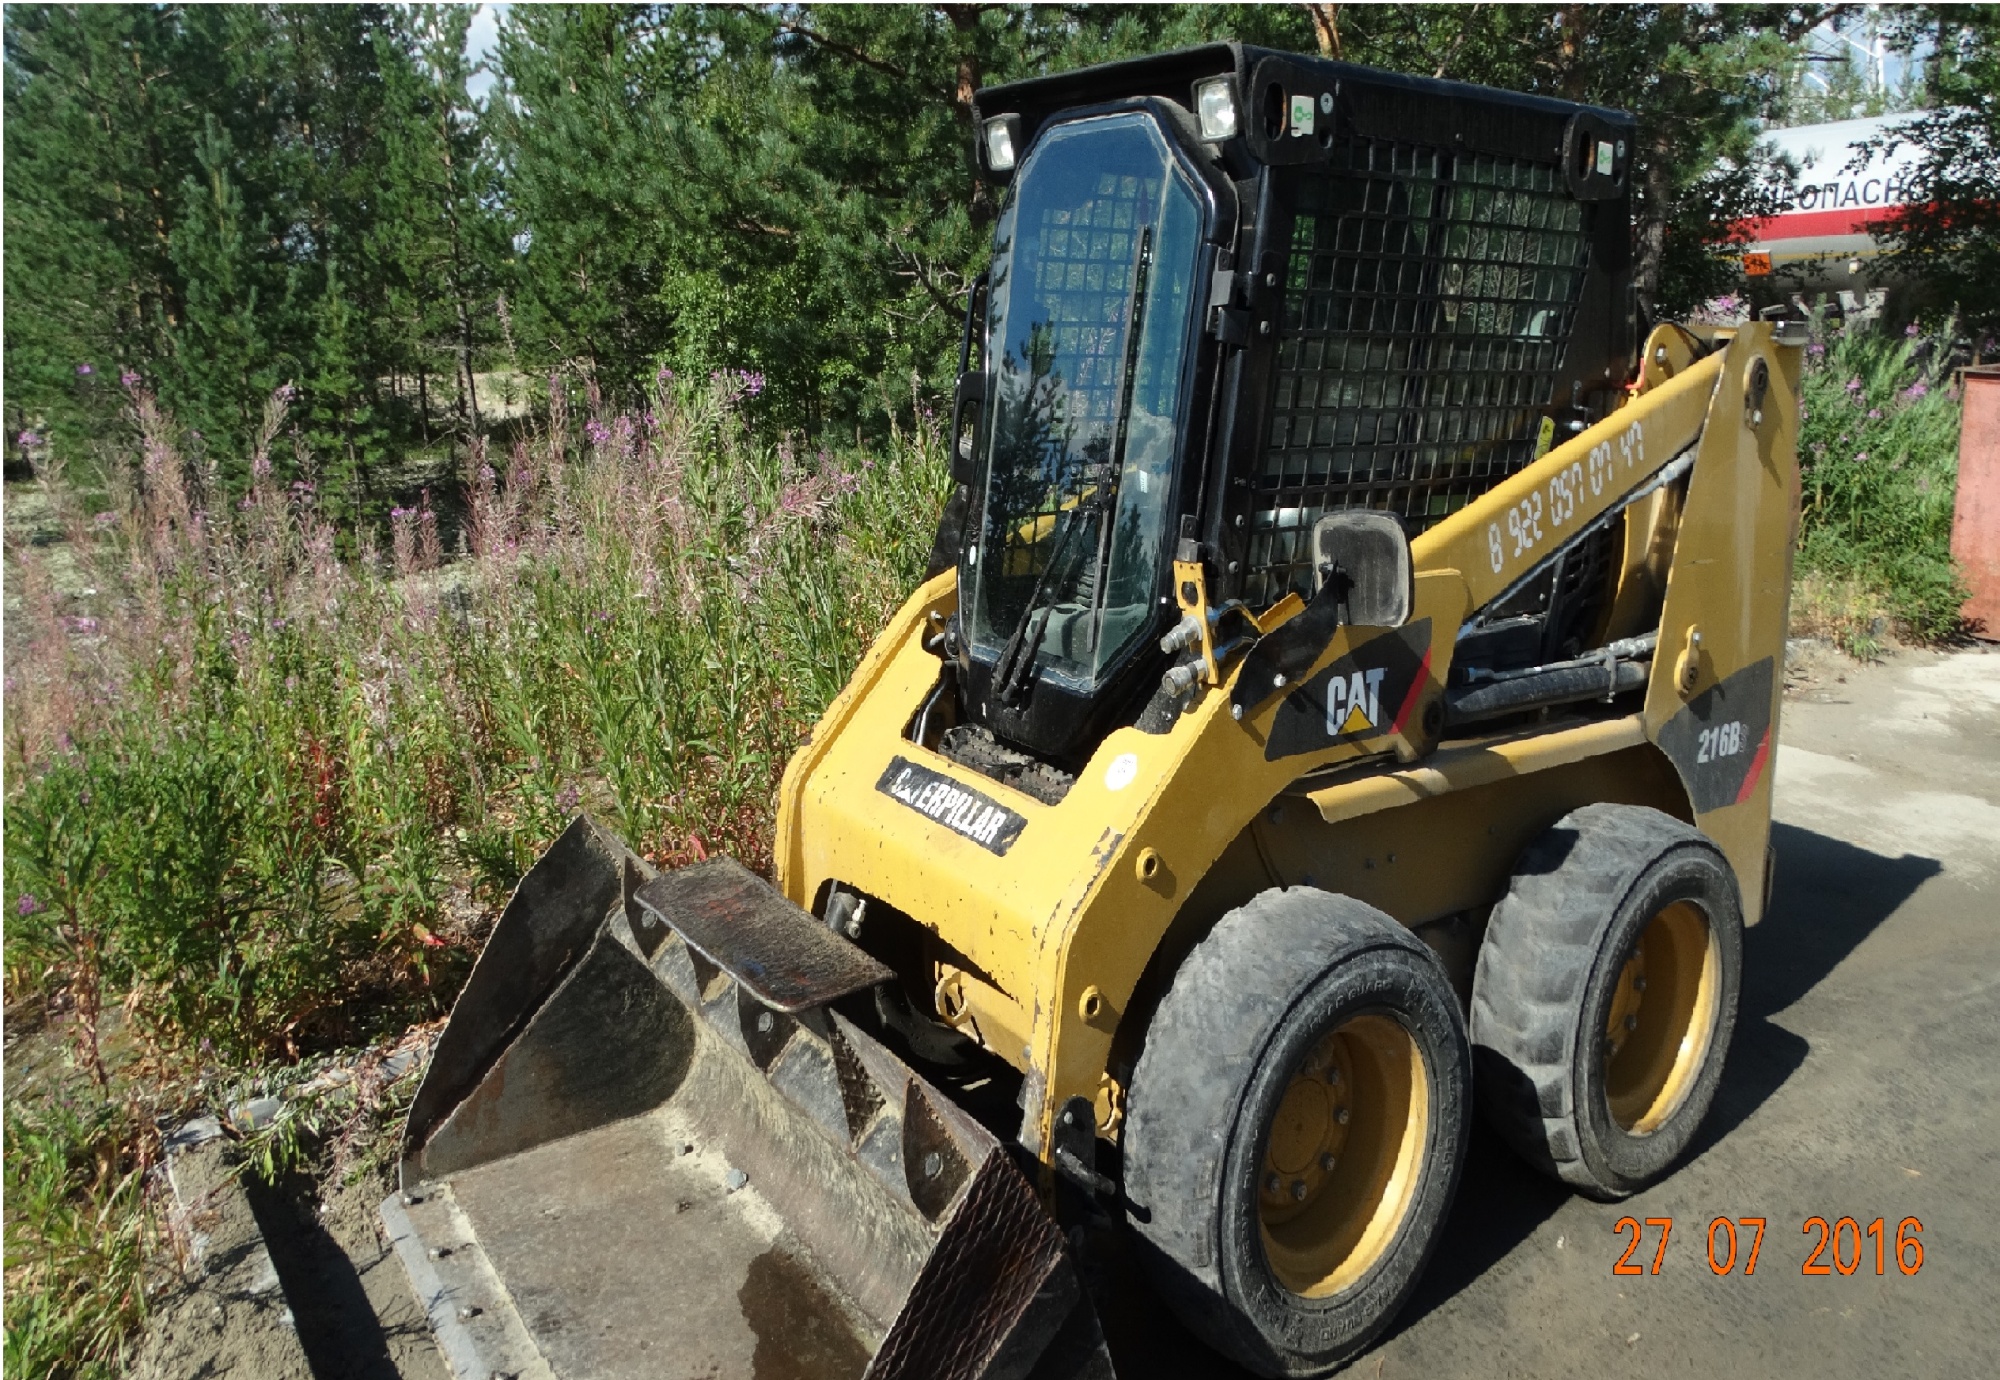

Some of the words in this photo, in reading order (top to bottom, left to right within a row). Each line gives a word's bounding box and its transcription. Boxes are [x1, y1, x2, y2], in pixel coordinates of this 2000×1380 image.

[1488, 523, 1503, 574] 8
[1509, 491, 1542, 558] 922
[1550, 462, 1584, 527] 057
[1589, 440, 1613, 496] 07
[1620, 420, 1644, 468] 47
[1326, 667, 1386, 736] CAT
[1697, 720, 1741, 764] 216B
[891, 767, 1008, 845] CERPILLAR
